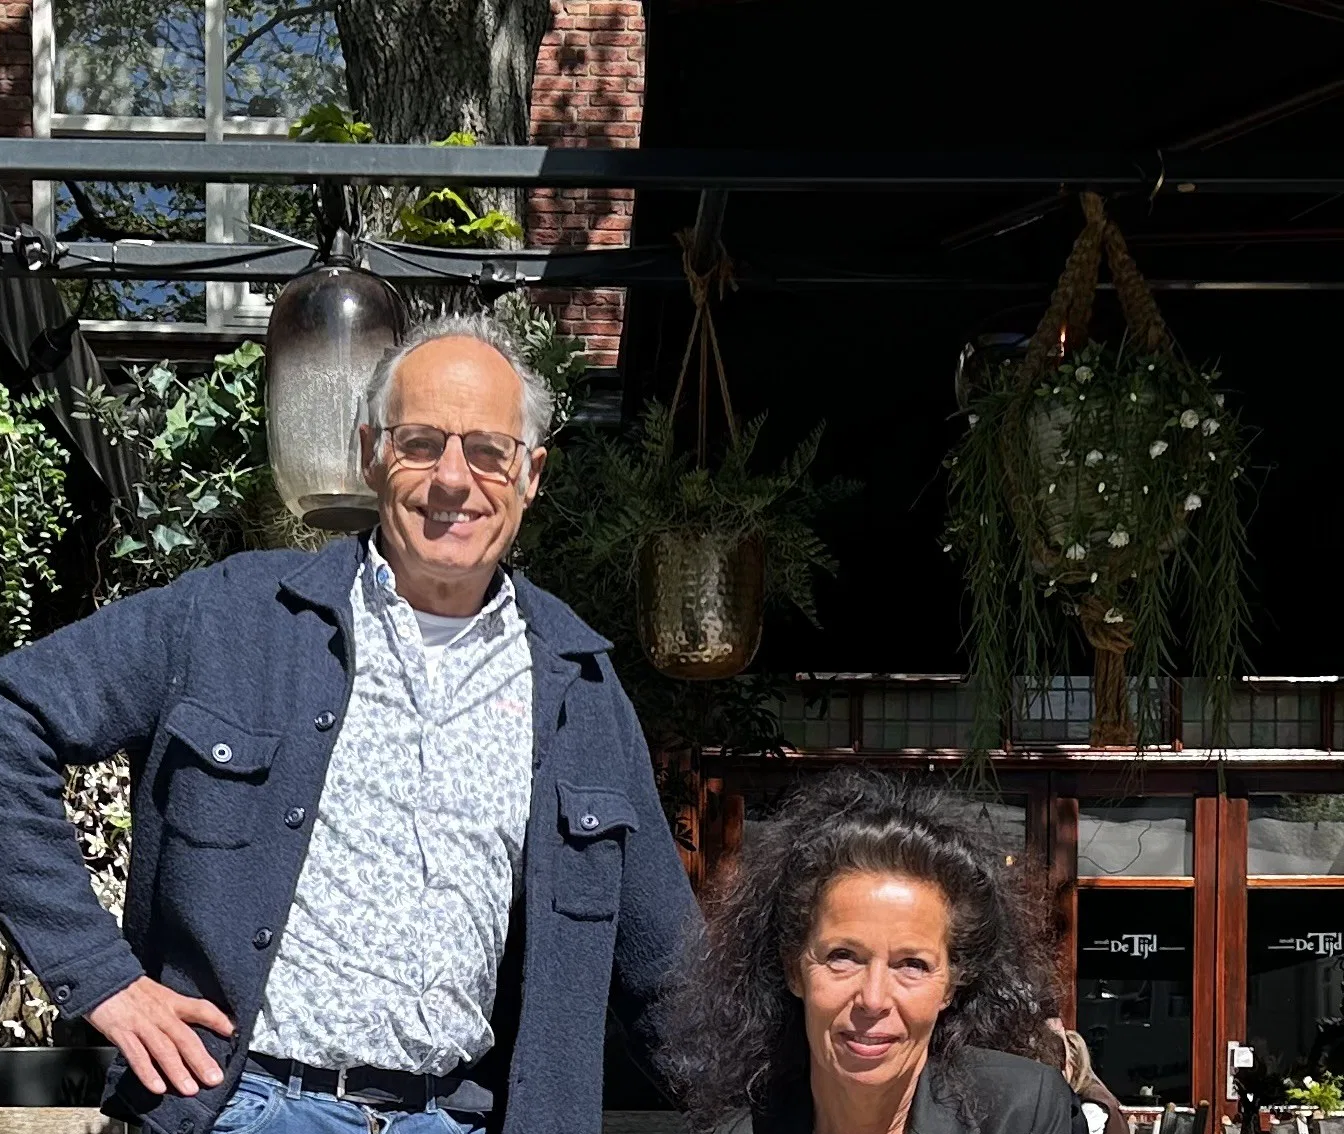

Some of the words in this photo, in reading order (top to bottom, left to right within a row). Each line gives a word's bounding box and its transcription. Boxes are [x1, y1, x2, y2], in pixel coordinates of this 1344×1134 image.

[1110, 939, 1129, 952] De
[1122, 933, 1157, 960] Tijd
[1295, 938, 1314, 951] De
[1307, 931, 1343, 957] Tijd
